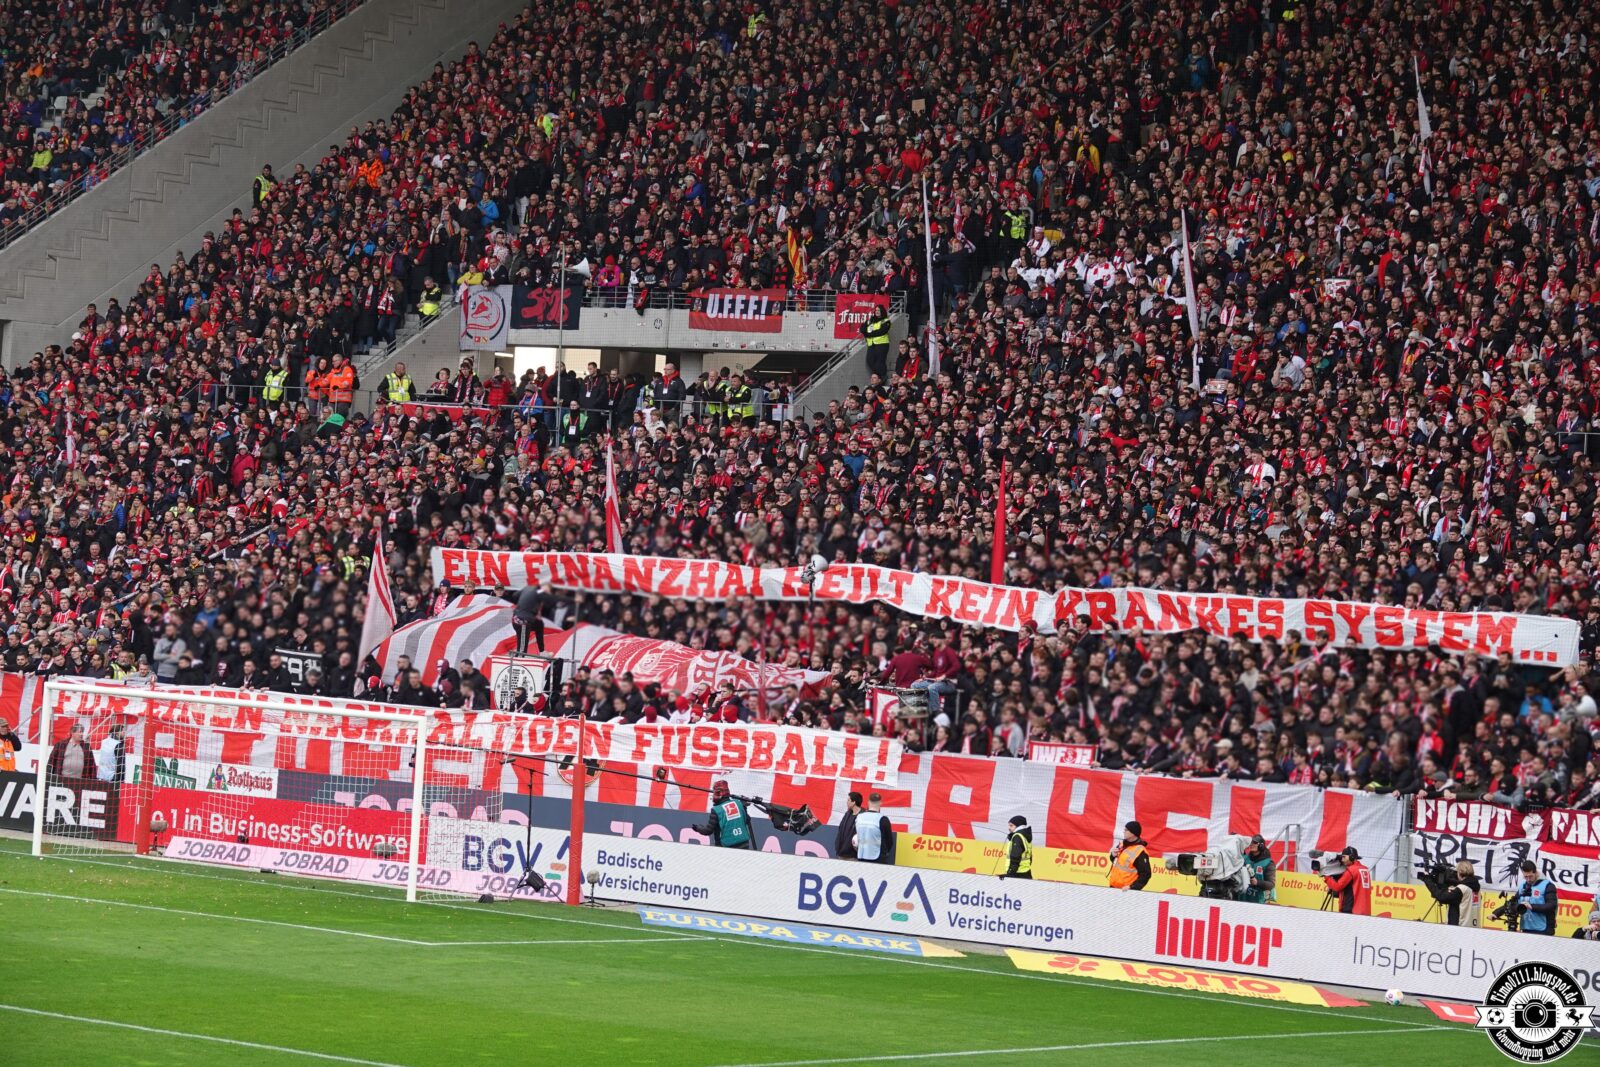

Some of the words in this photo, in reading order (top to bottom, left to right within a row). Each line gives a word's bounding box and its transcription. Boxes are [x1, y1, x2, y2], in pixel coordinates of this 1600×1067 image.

[706, 293, 769, 321] U.F.F.F.!
[442, 549, 496, 587] EIN
[525, 553, 764, 598] FINANZHAI
[922, 574, 1038, 628] KEIN
[1054, 587, 1285, 641] KRANKES
[1305, 600, 1558, 662] SYSTEM...
[631, 723, 890, 781] FUSSBALL!
[0, 780, 107, 830] ARE
[184, 807, 203, 832] in
[1416, 798, 1512, 838] FIGHT
[732, 827, 743, 837] 03
[927, 839, 964, 854] LOTTO
[178, 840, 251, 863] JOBRAD
[273, 851, 349, 874] JOBRAD
[461, 835, 543, 874] BGV
[597, 849, 663, 872] Badische
[1070, 854, 1109, 868] LOTTO
[596, 873, 709, 901] Versicherungen
[1541, 857, 1589, 888] Red
[797, 871, 888, 919] BGV
[948, 888, 1023, 912] Badische
[1375, 885, 1417, 901] LOTTO
[643, 910, 799, 939] EUROPA
[807, 929, 917, 952] PARK
[947, 911, 1074, 943] Versicherungen
[1155, 900, 1283, 968] huber
[1353, 936, 1462, 976] Inspired
[1120, 962, 1281, 994] LOTTO
